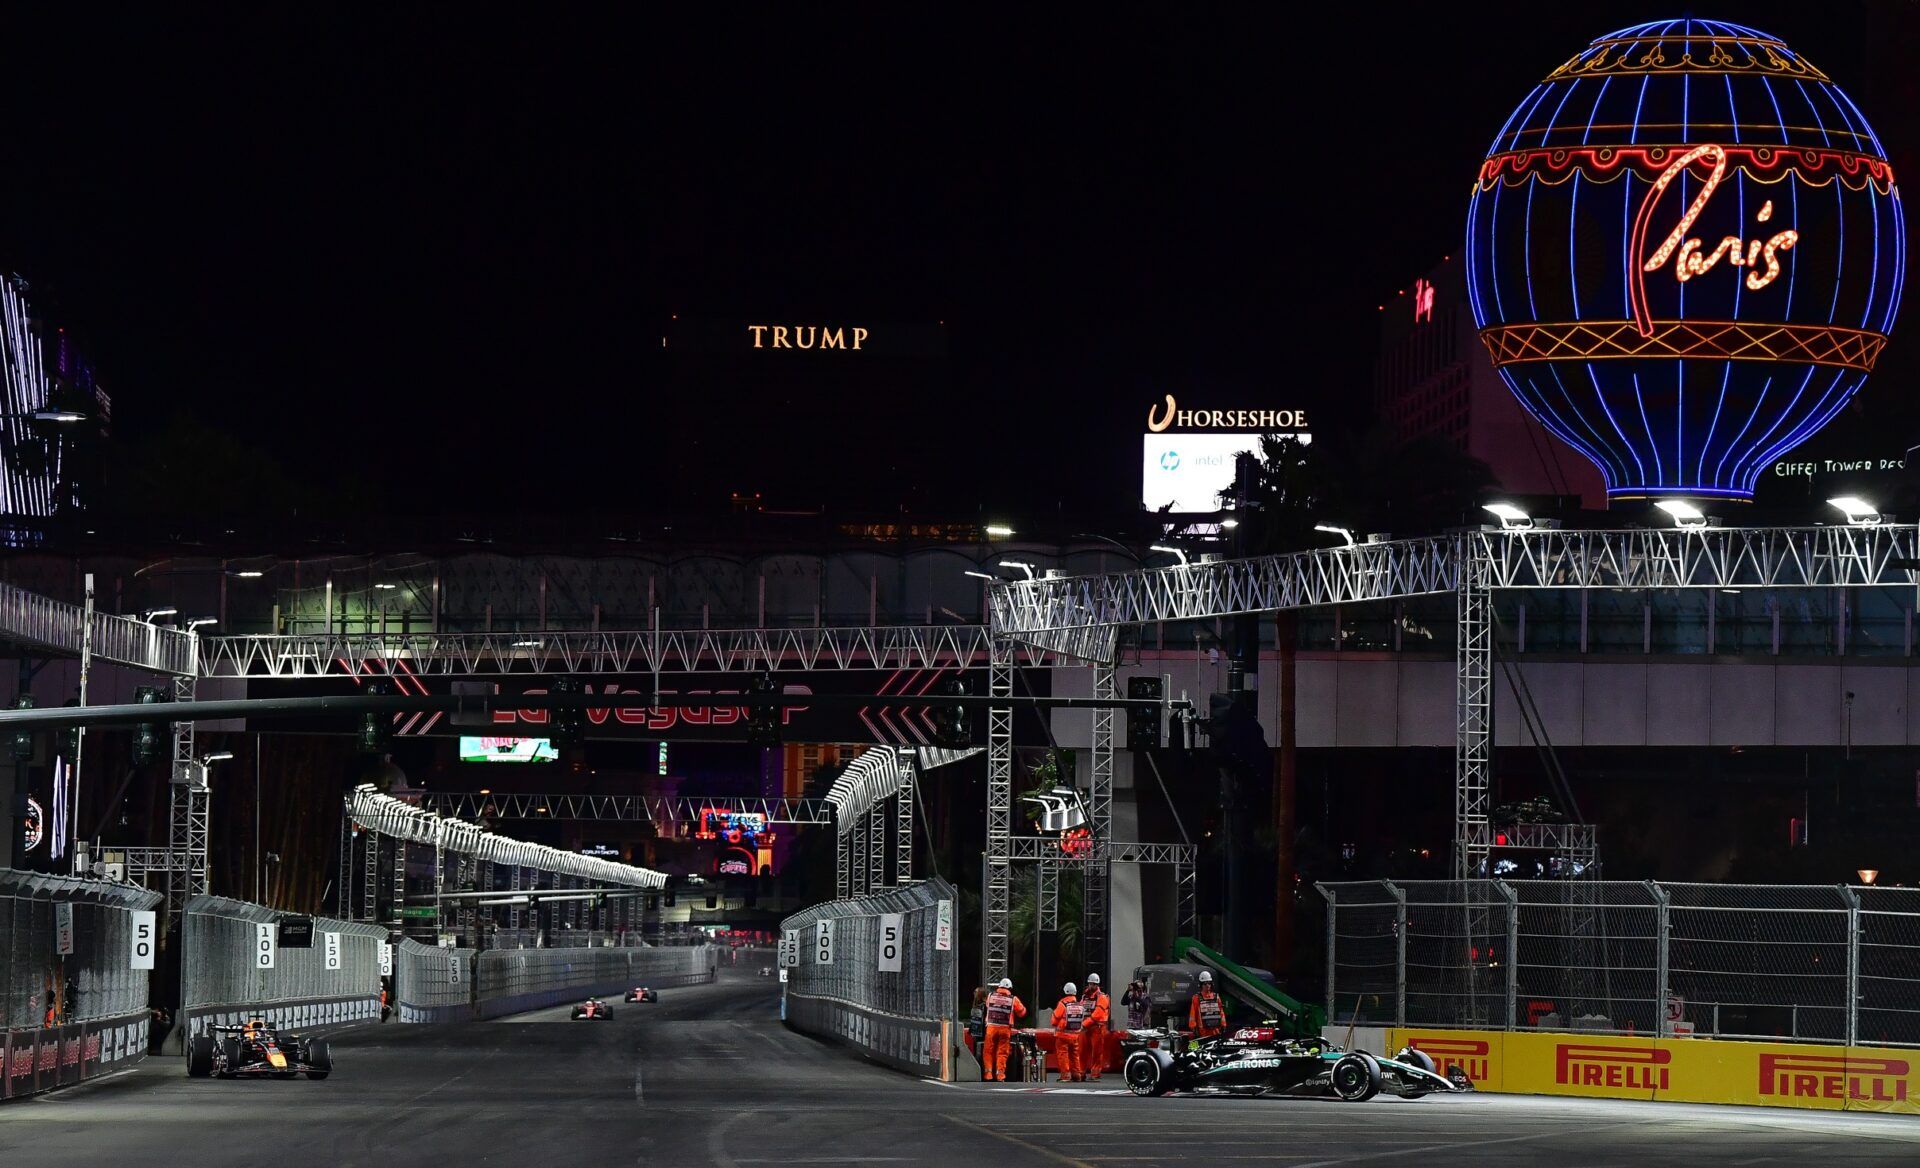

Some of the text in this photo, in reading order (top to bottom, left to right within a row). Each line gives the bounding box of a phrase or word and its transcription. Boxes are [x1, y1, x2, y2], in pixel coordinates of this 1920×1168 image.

[1629, 143, 1798, 338] Paris
[748, 325, 868, 350] TRUMP
[1824, 460, 1872, 472] TOWER
[136, 924, 149, 957] 50
[260, 926, 270, 966] 100
[328, 934, 337, 967] 150
[788, 932, 796, 965] 150
[820, 922, 829, 962] 100
[883, 927, 896, 960] 50
[1227, 1058, 1281, 1069] PETRONAS
[1556, 1044, 1672, 1090] PIRELLI
[1759, 1053, 1910, 1100] PIRELLI
